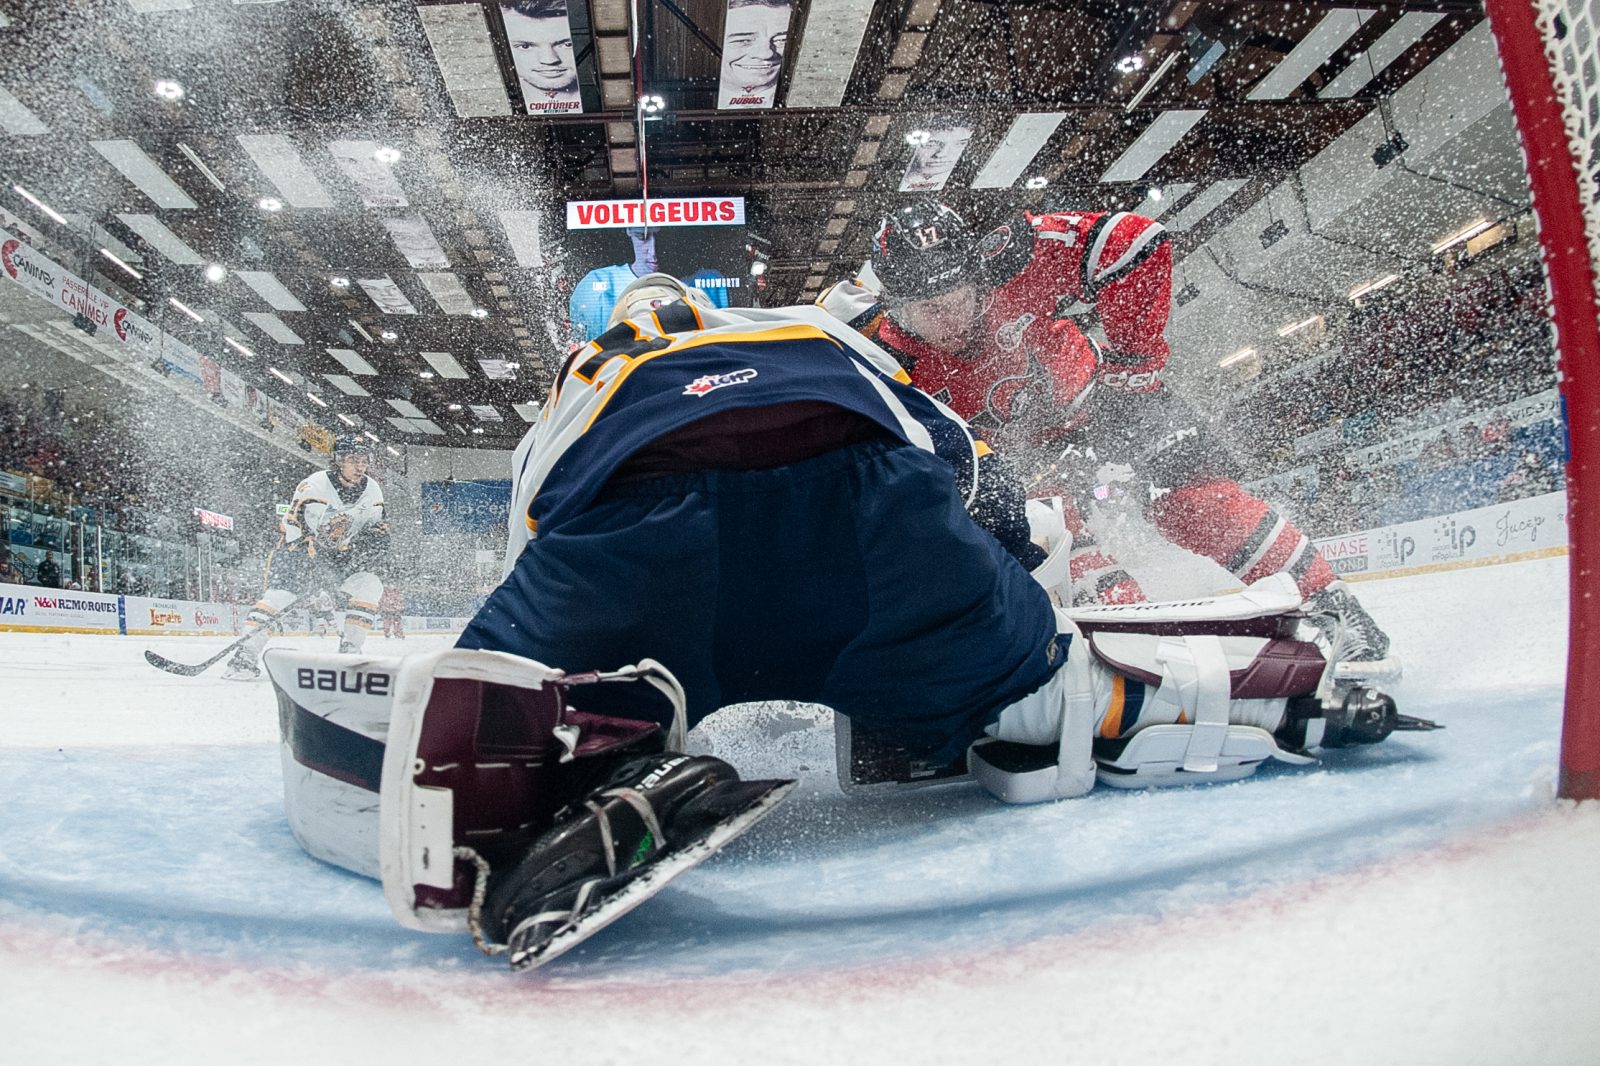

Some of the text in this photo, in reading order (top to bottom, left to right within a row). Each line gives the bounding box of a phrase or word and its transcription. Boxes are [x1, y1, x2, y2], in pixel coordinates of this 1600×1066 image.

[529, 101, 580, 110] COUTURIER
[729, 96, 765, 105] DUBOIS
[576, 201, 736, 225] VOLTIGEURS
[694, 277, 740, 288] WOODWORTH
[62, 288, 109, 328] CANIMEX
[58, 598, 117, 613] REMORQUES
[149, 608, 183, 626] Lemaire
